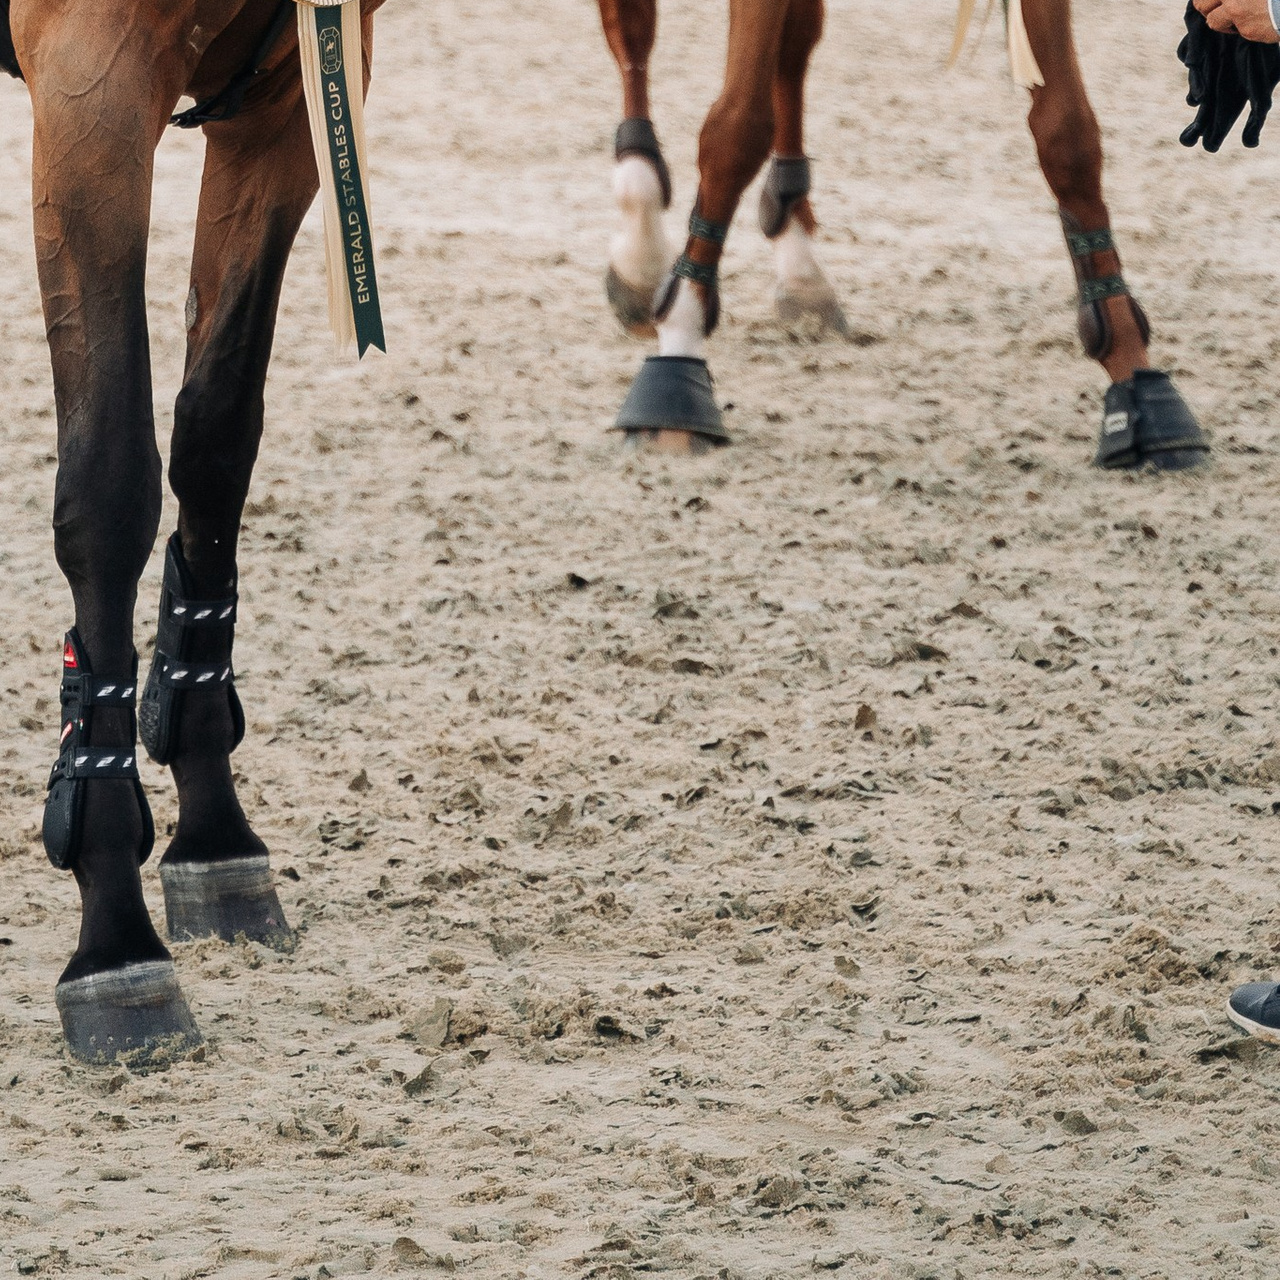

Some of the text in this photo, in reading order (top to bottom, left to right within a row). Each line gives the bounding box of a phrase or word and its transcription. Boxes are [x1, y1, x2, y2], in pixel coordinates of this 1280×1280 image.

[328, 81, 343, 120] CUP
[334, 124, 356, 207] STABLES
[348, 211, 370, 304] EMERALD
